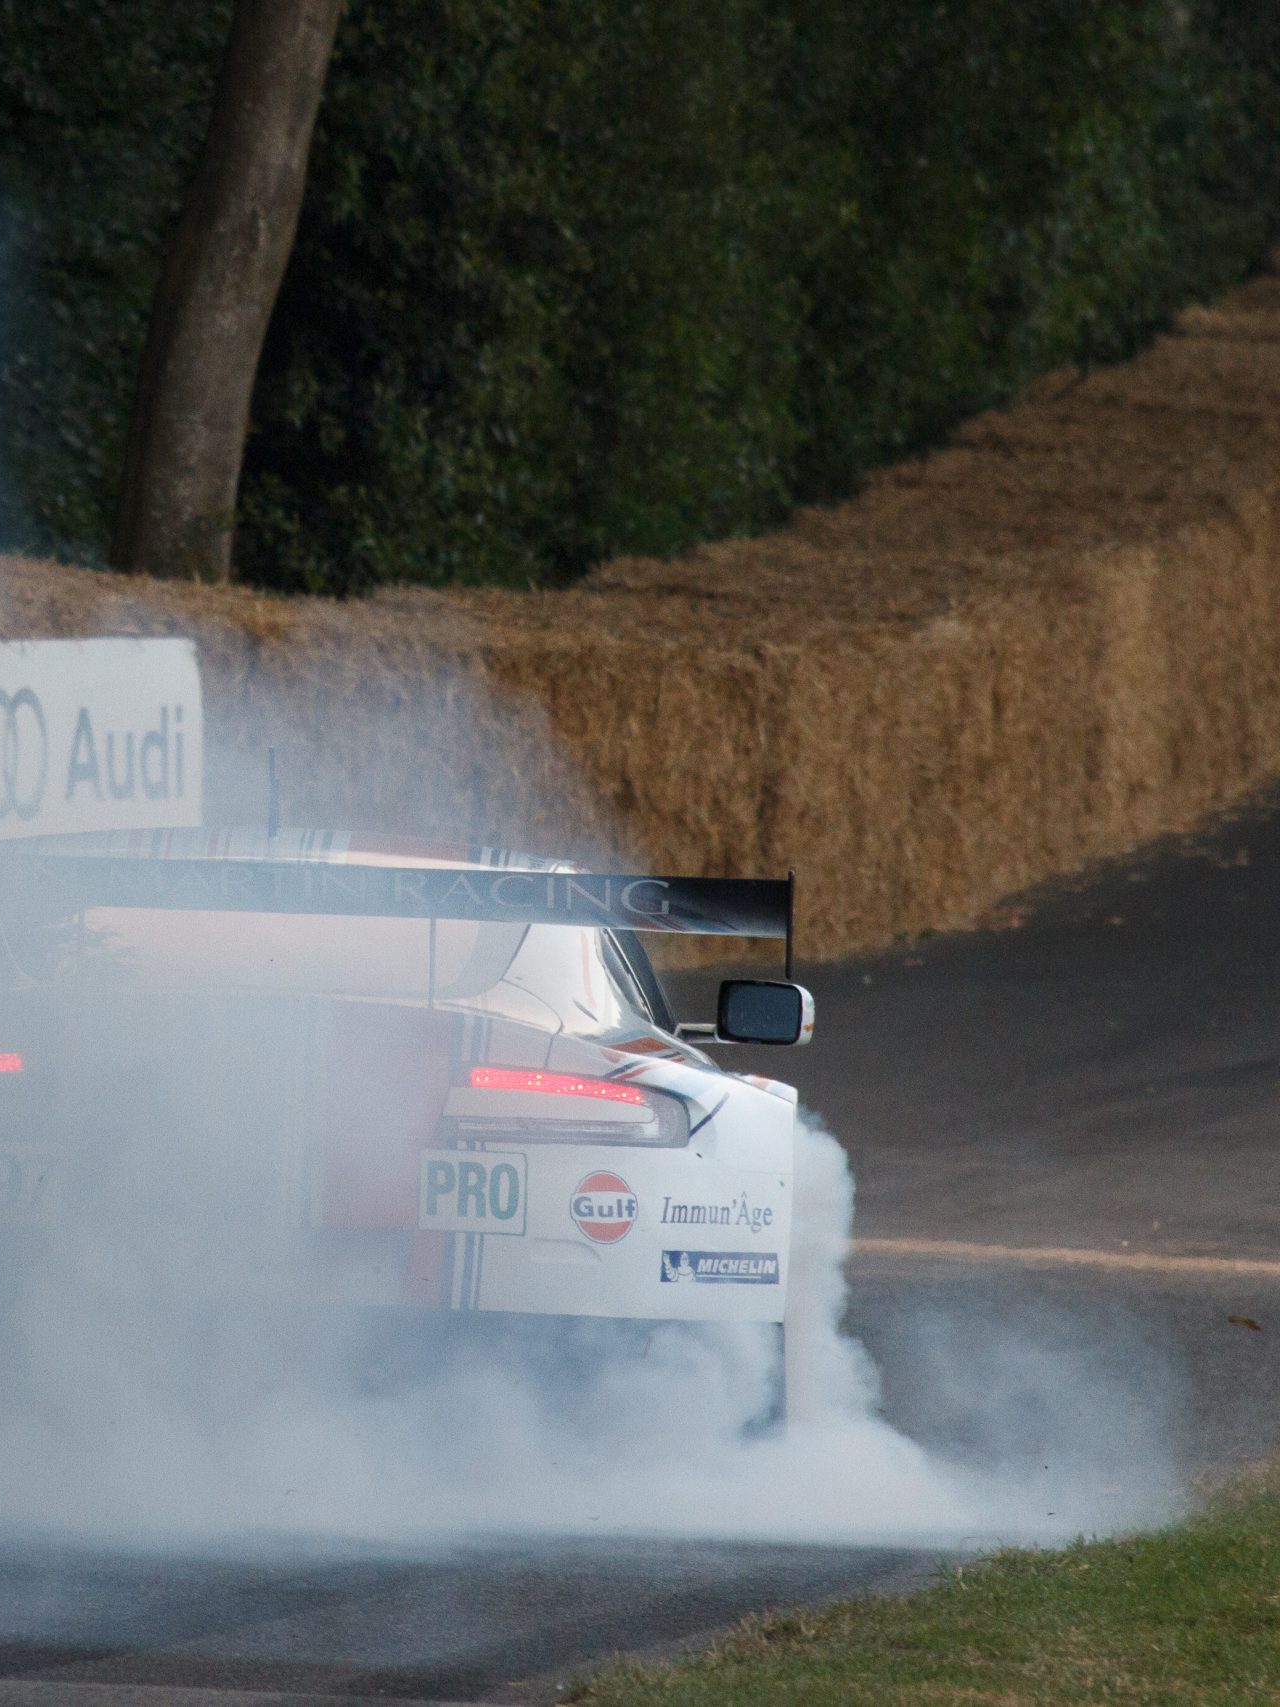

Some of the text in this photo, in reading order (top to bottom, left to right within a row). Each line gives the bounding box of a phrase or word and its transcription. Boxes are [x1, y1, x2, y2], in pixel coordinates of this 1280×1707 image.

[66, 705, 184, 801] Audi
[393, 871, 671, 917] RACING
[425, 1159, 519, 1221] PRO
[573, 1196, 637, 1219] Gulf
[696, 1258, 777, 1276] MICHELIN
